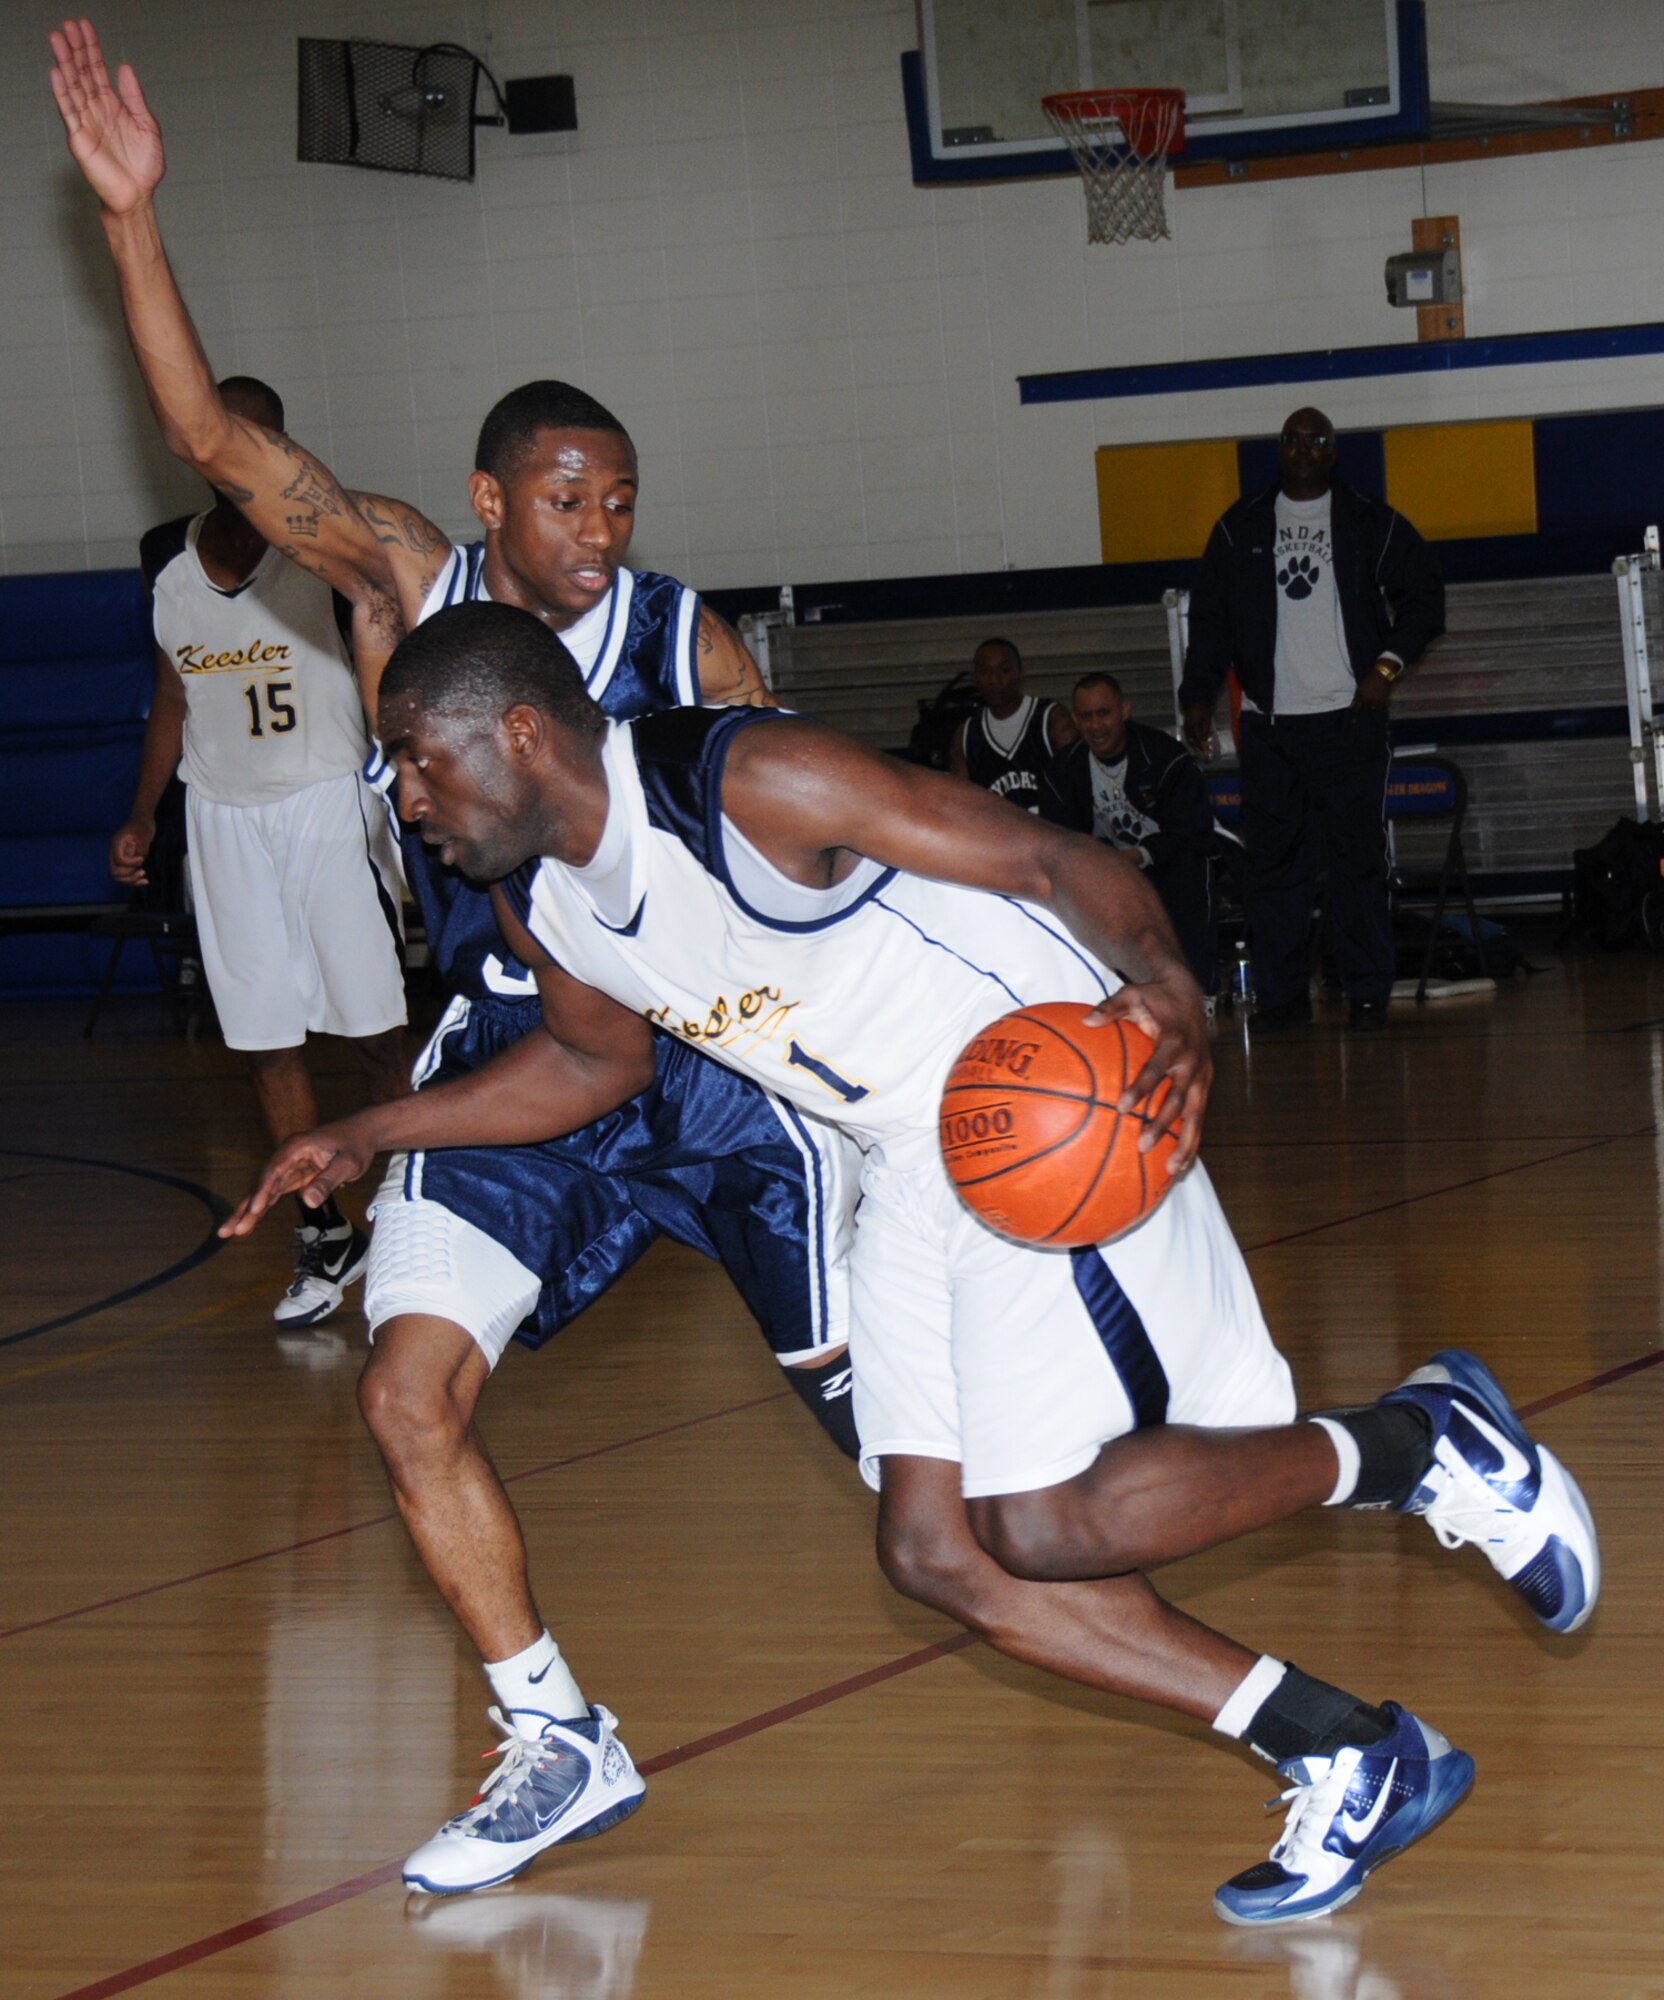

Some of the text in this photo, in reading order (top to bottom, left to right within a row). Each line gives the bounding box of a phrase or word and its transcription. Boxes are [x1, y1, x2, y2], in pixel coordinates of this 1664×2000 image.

[176, 638, 292, 673] Keesler
[244, 680, 298, 738] 15
[785, 1036, 873, 1104] 1
